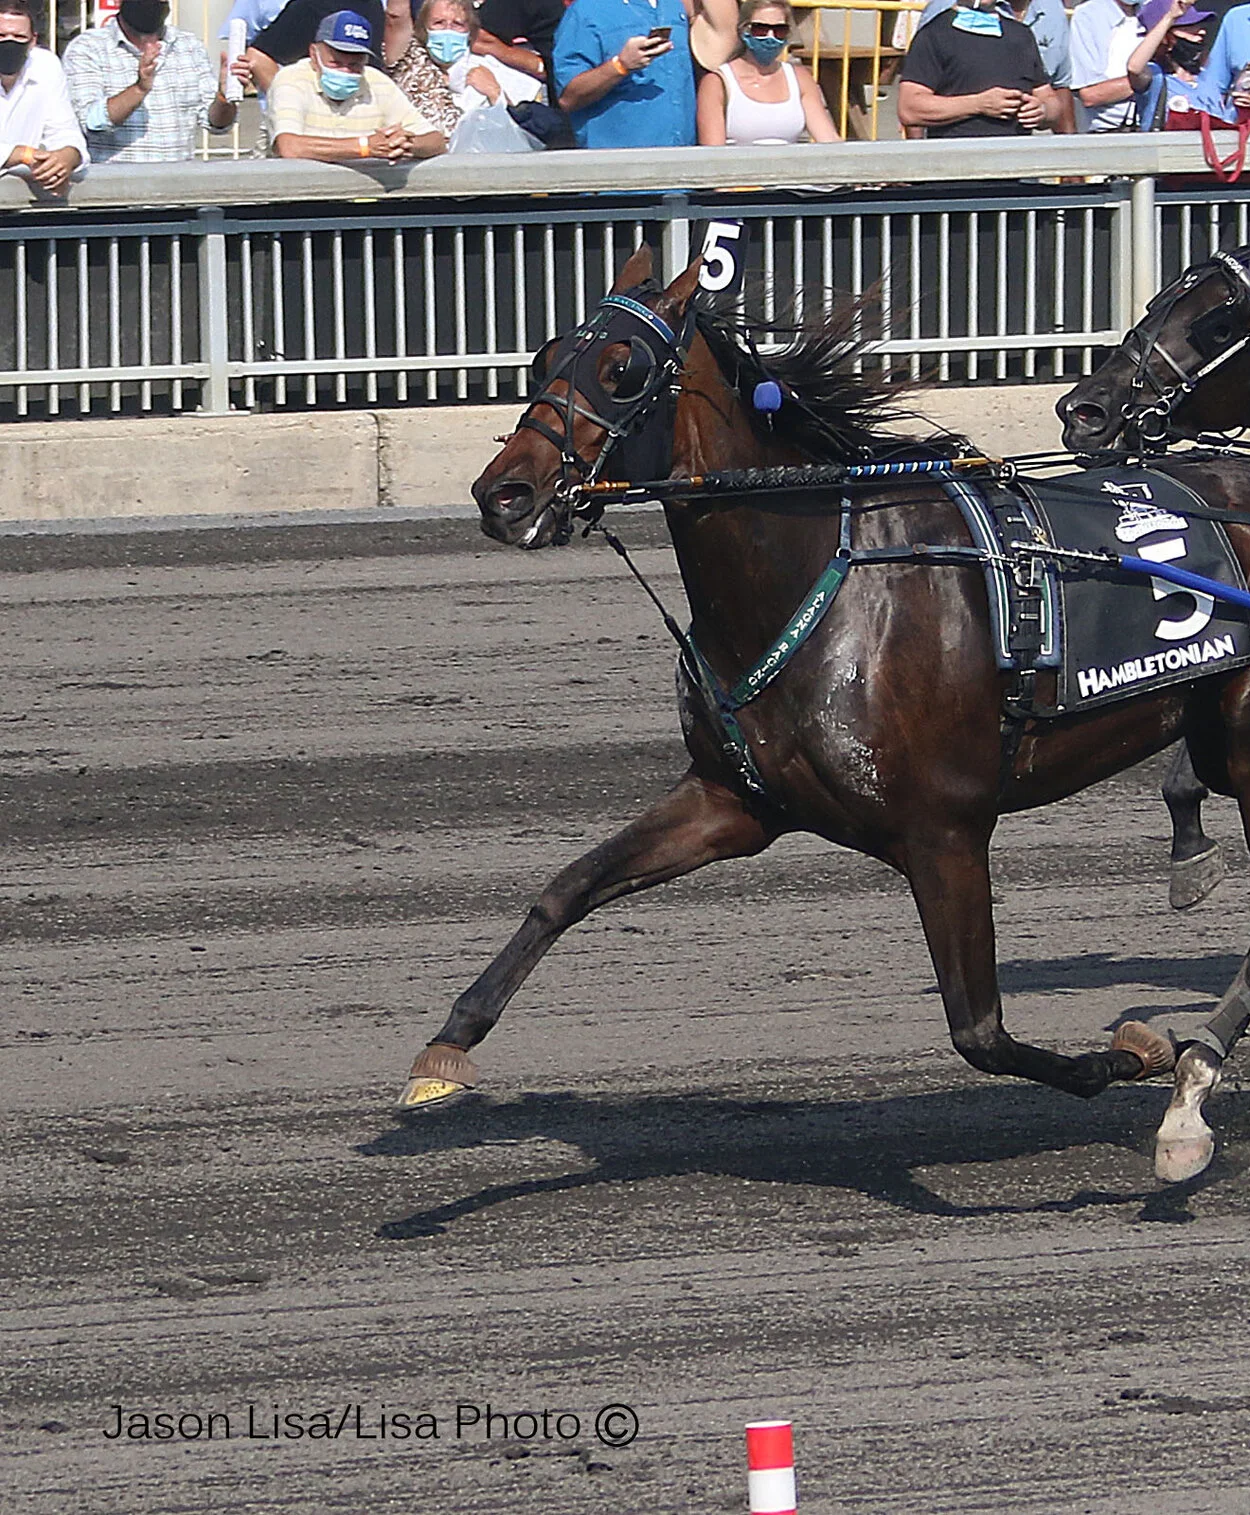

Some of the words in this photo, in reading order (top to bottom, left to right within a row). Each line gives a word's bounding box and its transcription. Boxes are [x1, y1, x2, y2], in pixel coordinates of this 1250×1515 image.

[698, 221, 741, 291] 5
[1137, 536, 1215, 641] 5
[1076, 634, 1236, 699] HAMBLETONIAN
